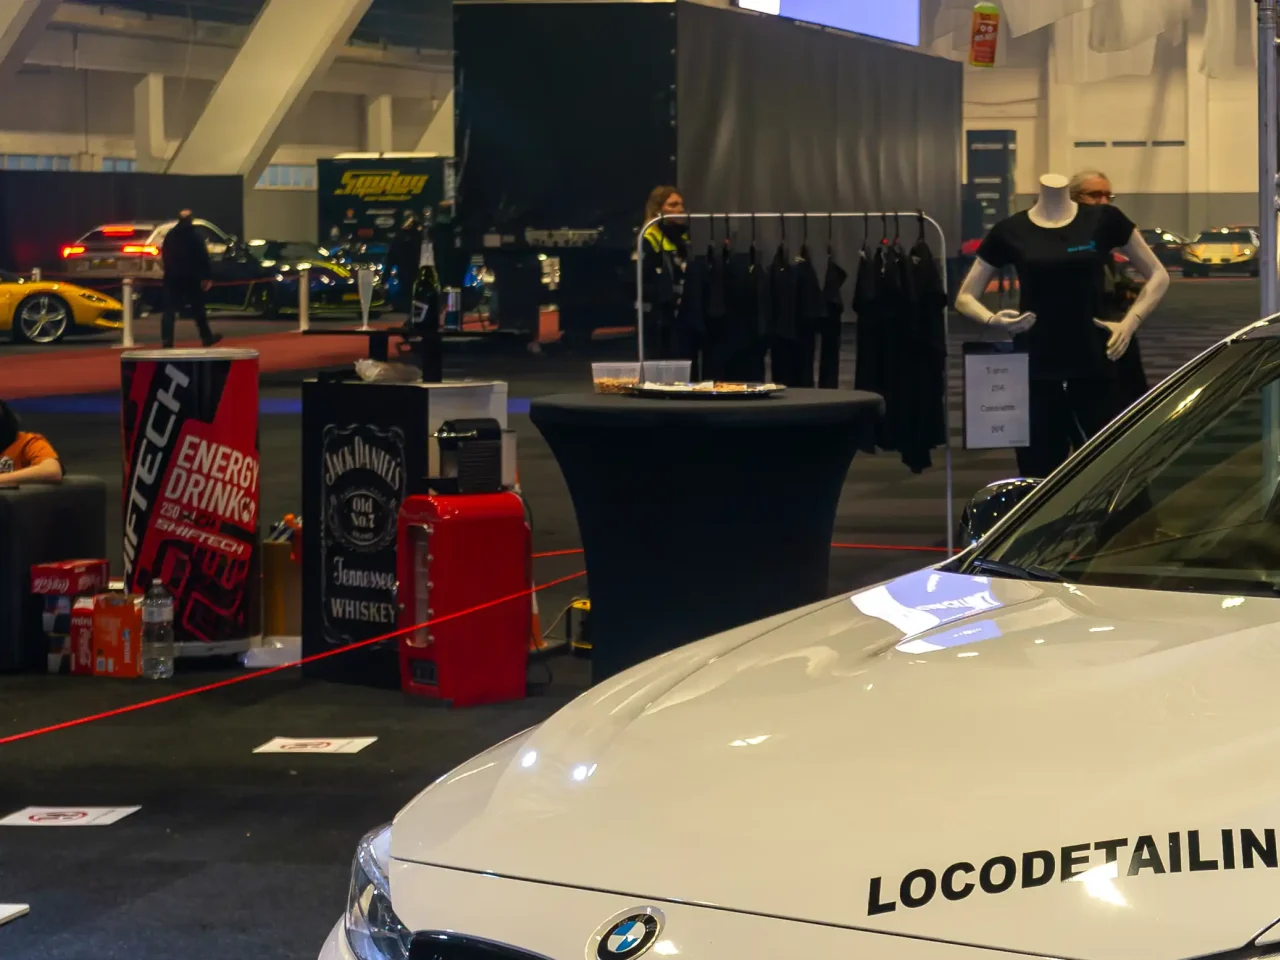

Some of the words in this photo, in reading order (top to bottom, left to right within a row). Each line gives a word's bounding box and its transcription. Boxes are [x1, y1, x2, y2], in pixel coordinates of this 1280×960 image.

[177, 435, 259, 493] ENERGY
[326, 446, 355, 487] JACK
[353, 498, 373, 513] Old
[155, 517, 245, 555] SHIFTECH
[333, 556, 395, 590] Tennessee
[330, 598, 396, 624] WHISKEY
